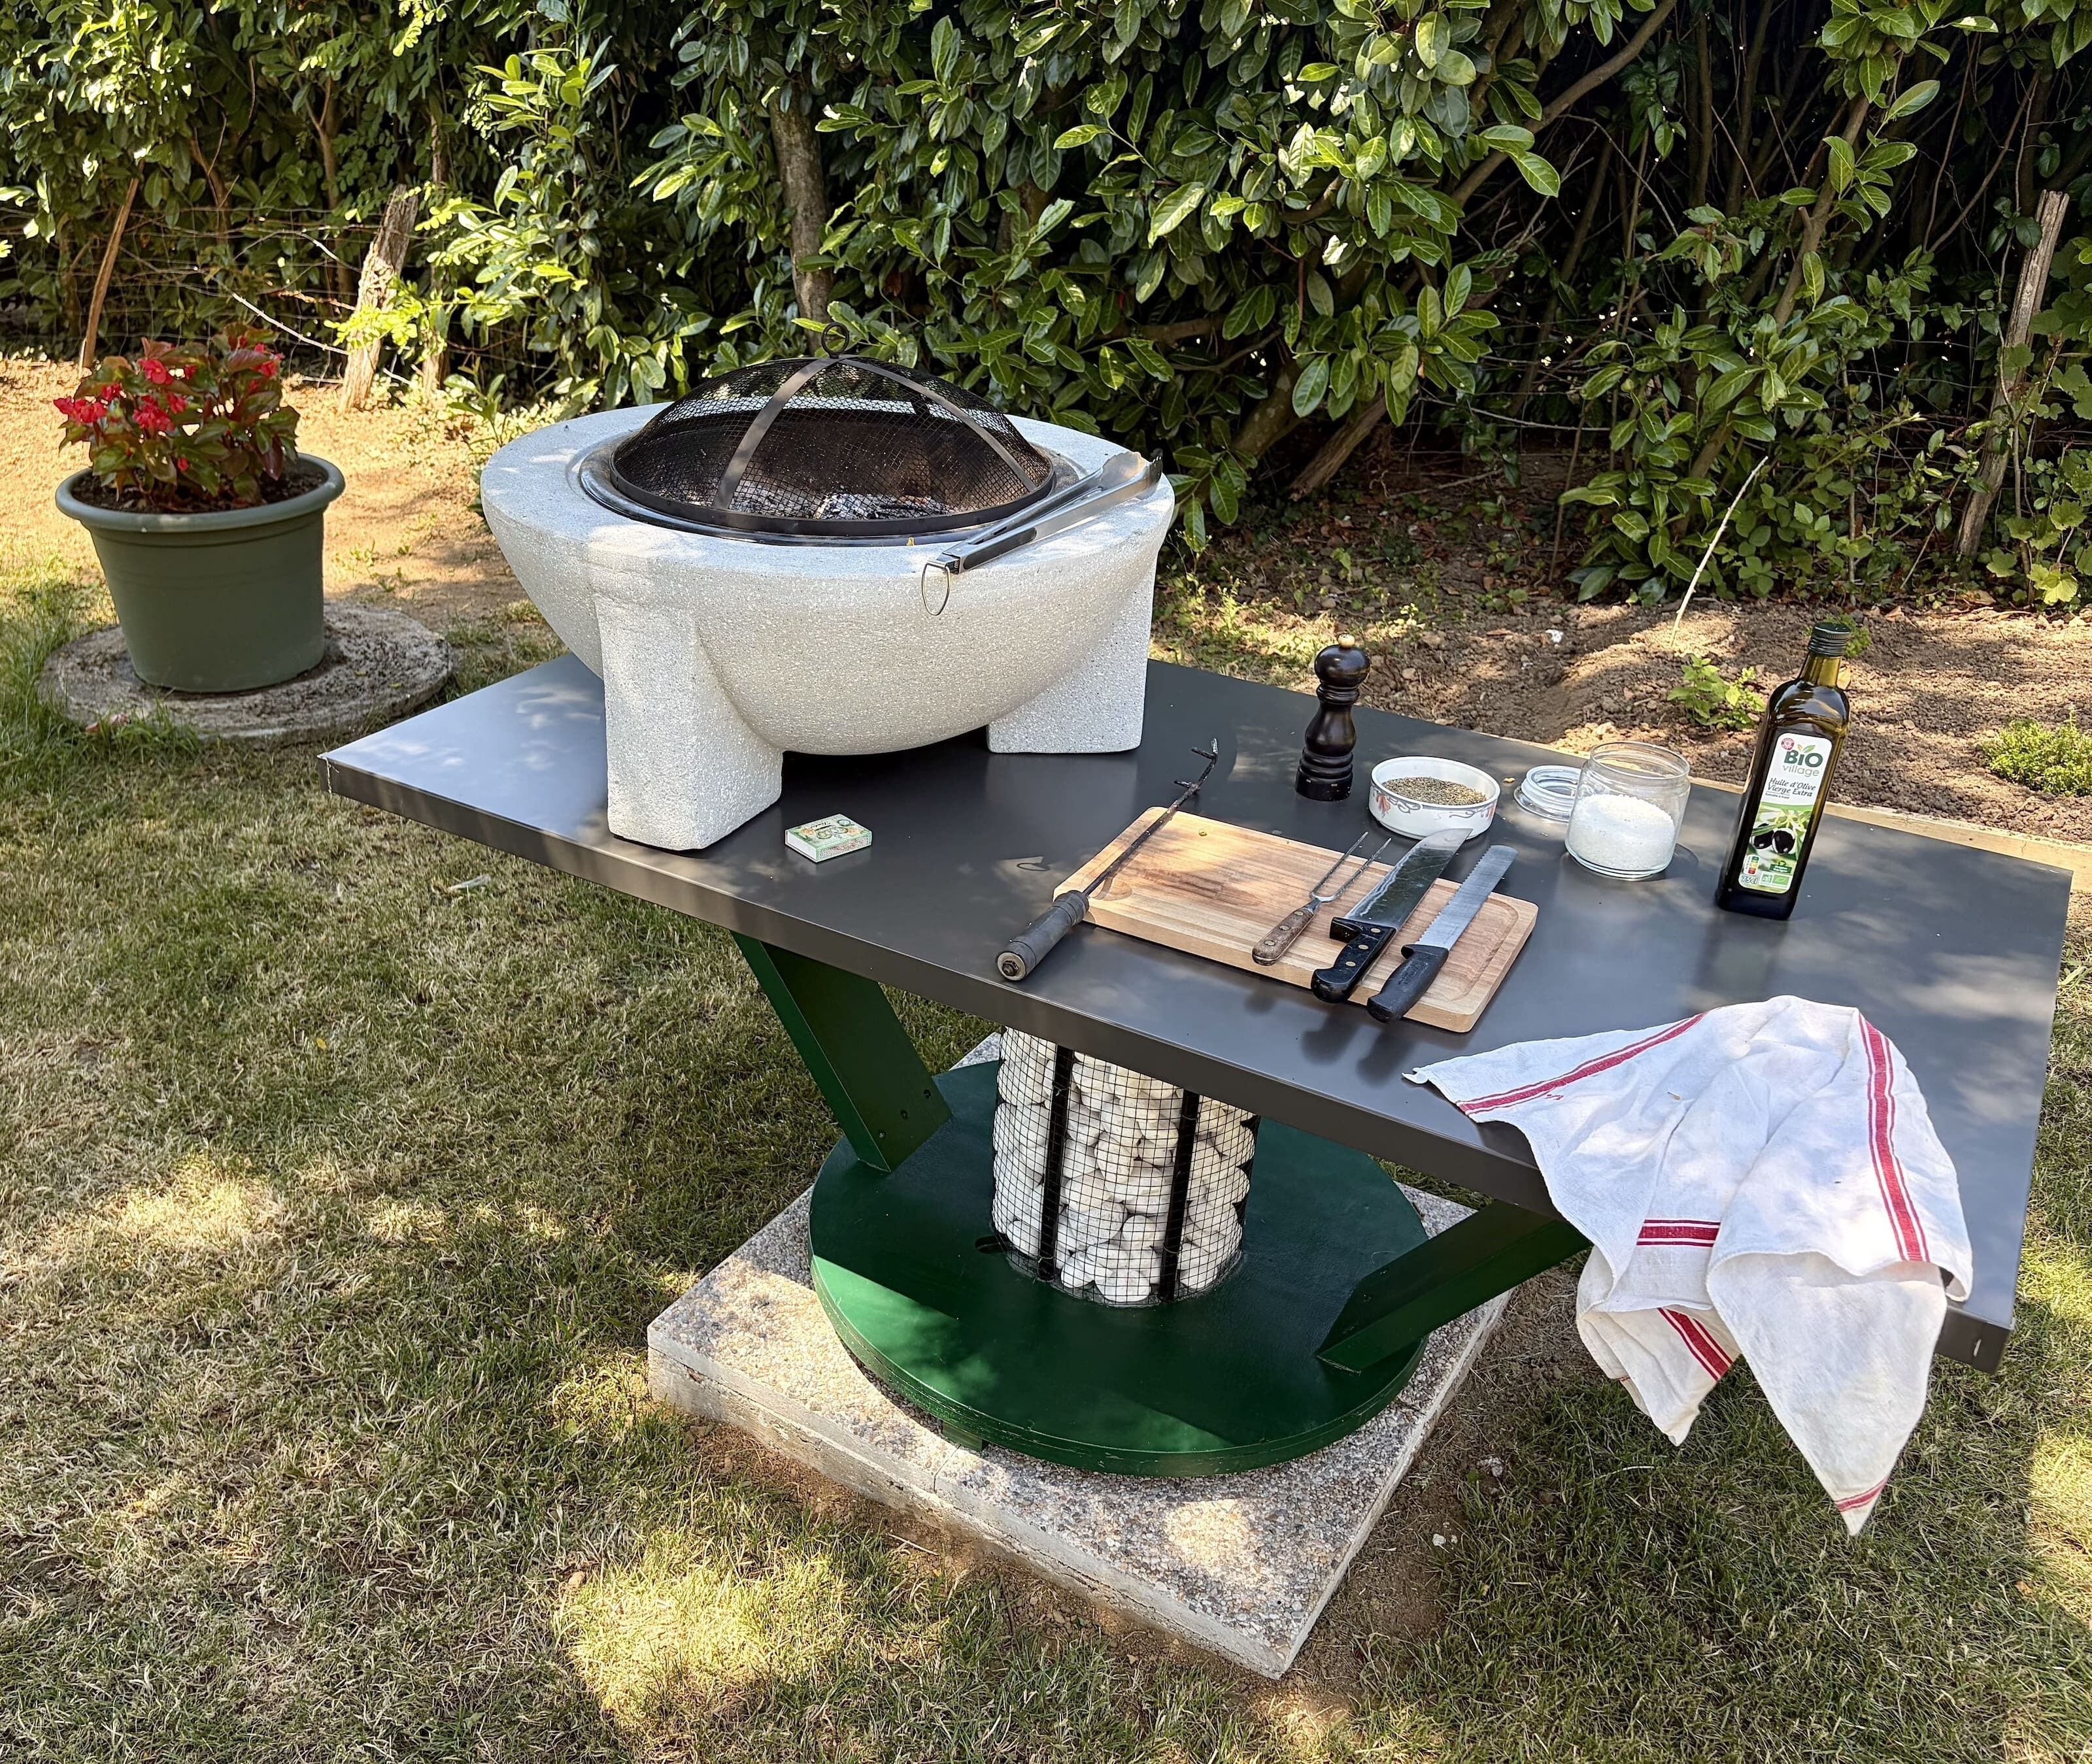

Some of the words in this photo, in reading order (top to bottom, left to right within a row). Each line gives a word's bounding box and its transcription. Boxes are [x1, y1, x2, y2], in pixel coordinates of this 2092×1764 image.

[1783, 765, 1819, 777] village
[1767, 784, 1791, 794] Vierge
[1792, 788, 1813, 797] Extra
[1769, 778, 1789, 787] Huile
[1789, 782, 1816, 791] d'Olive
